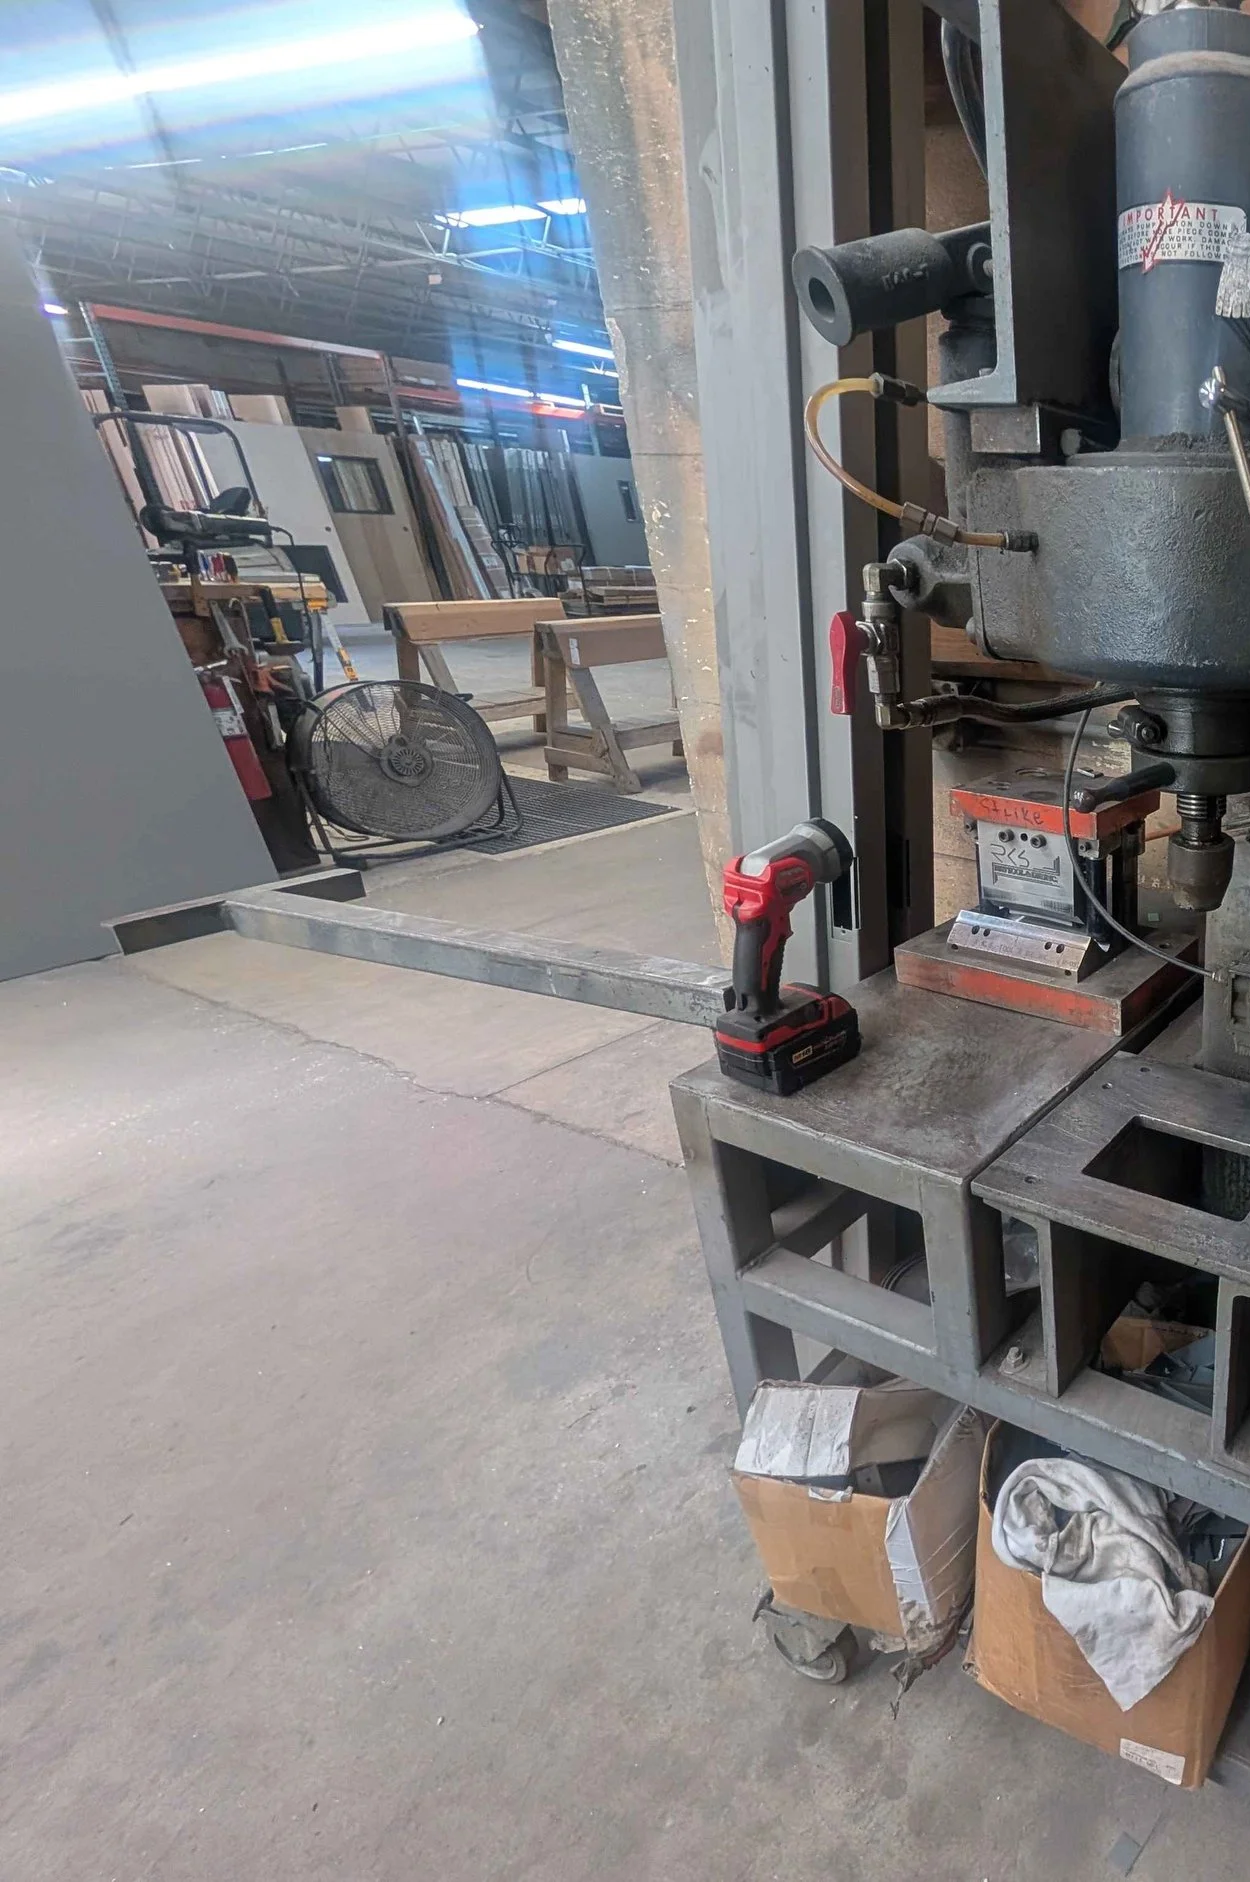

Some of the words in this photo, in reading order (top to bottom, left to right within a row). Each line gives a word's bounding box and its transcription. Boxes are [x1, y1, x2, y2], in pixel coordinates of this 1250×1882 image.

[1122, 205, 1218, 226] IMPORTANT
[1199, 221, 1228, 230] DOWN
[1177, 228, 1203, 236] PIECE
[1200, 243, 1221, 252] THIS
